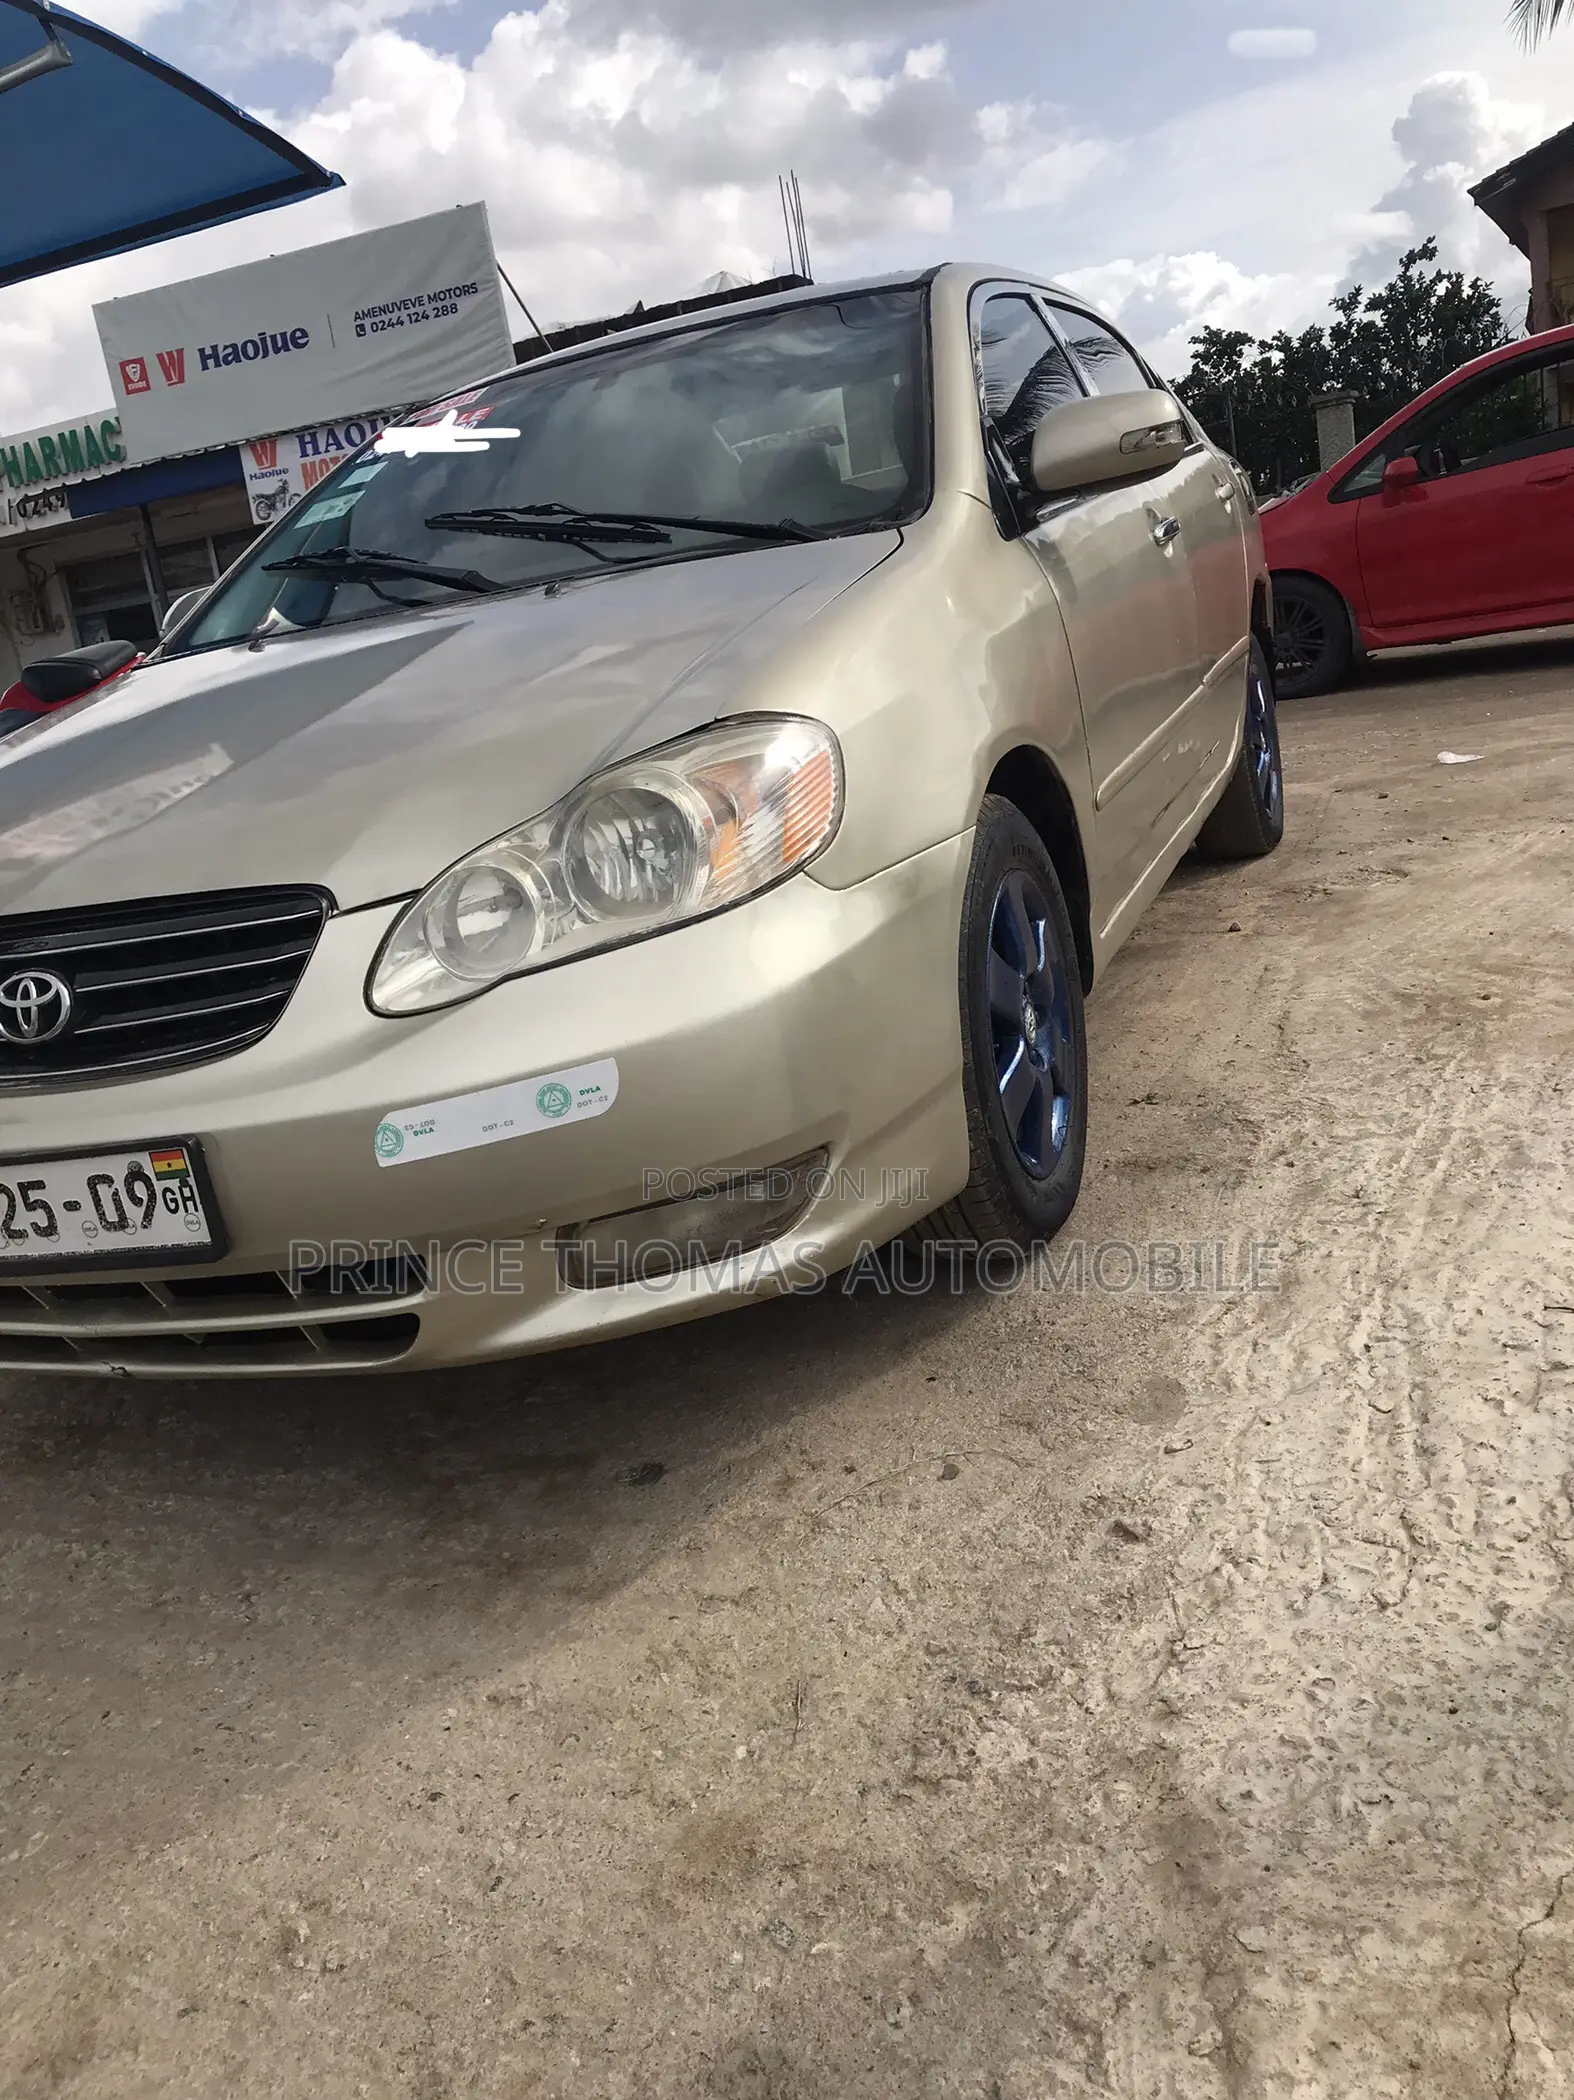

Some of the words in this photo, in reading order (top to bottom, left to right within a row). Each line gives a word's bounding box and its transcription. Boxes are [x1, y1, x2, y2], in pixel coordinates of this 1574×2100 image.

[353, 295, 426, 322] AMENUVEVE
[426, 282, 479, 305] MOTORS
[370, 315, 405, 333] 0244
[406, 309, 430, 324] 124
[432, 302, 459, 319] 288
[196, 326, 311, 372] Haojue
[0, 416, 124, 488] HARMAC
[301, 453, 350, 490] MOT
[578, 1085, 602, 1096] DVLA
[413, 1127, 435, 1137] DVLA
[161, 1184, 199, 1215] GH
